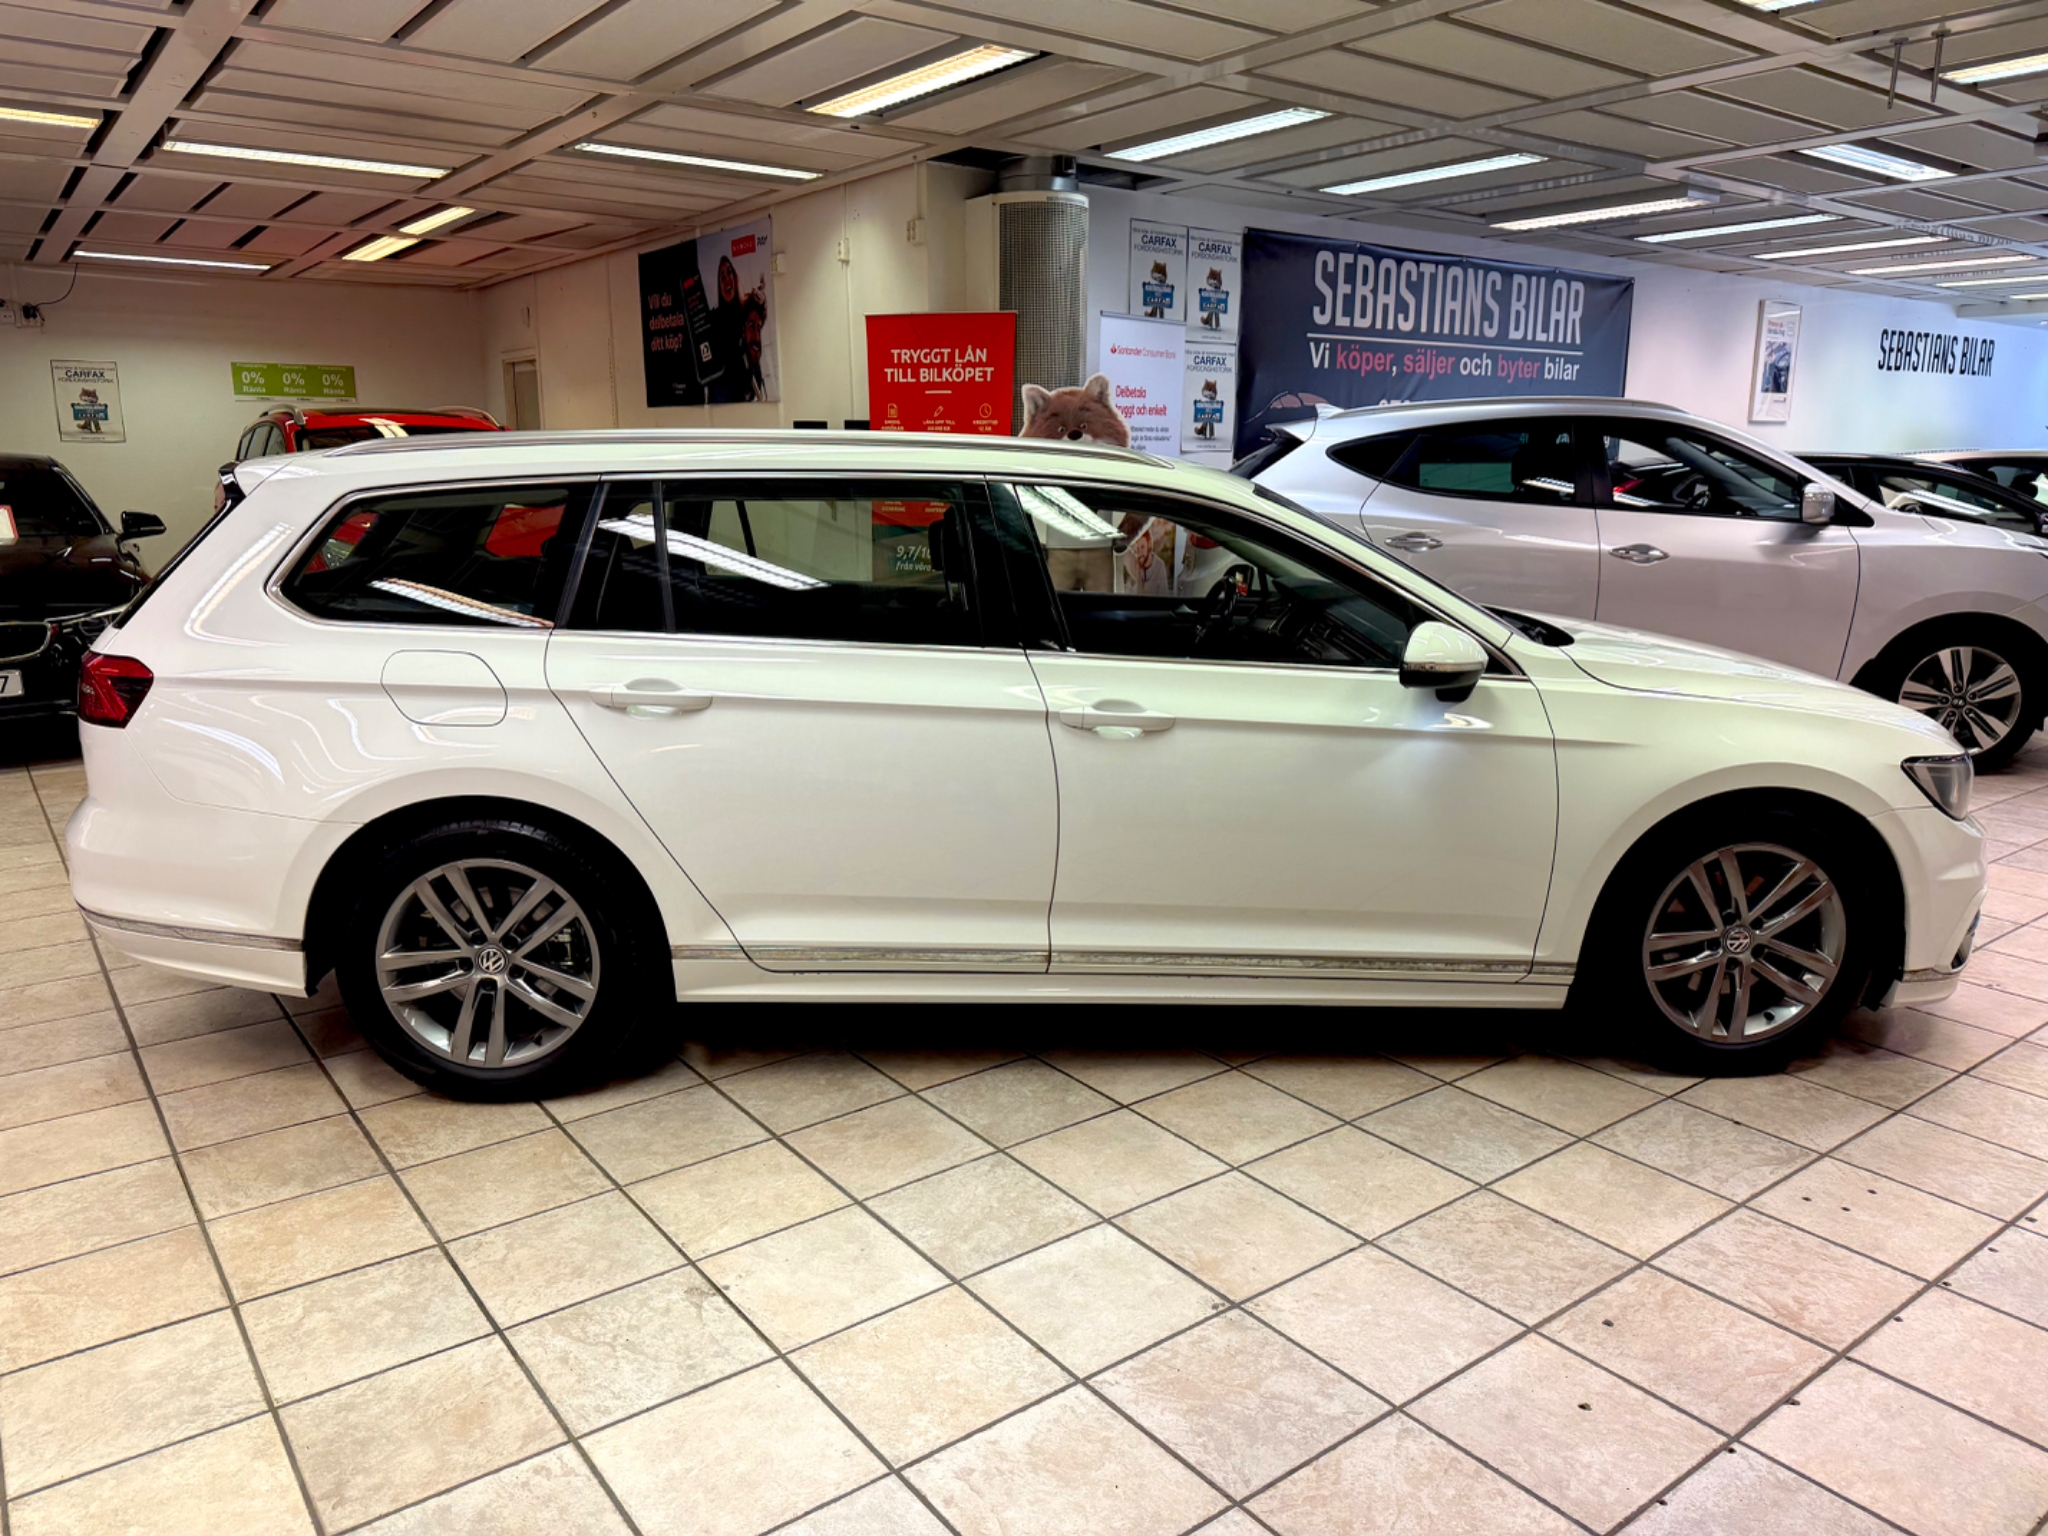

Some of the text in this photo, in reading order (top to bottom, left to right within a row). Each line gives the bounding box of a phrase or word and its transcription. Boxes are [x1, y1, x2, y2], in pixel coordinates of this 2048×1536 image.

[1140, 234, 1177, 249] CARFAX
[1198, 241, 1233, 256] CARFAX
[661, 291, 672, 308] du
[1312, 249, 1586, 345] SEBASTIANS BILAR
[890, 344, 988, 364] TRYGGT LÅN
[1193, 354, 1228, 367] CARFAX
[1877, 328, 1996, 378] SEBASTIANS BILAR
[1309, 341, 1581, 384] Vi köper, säljer och byter bilar
[241, 370, 265, 385] 0%
[282, 372, 305, 386] 0%
[322, 373, 344, 387] 0%
[884, 363, 995, 383] TILL BILKÖPET
[243, 385, 266, 394] Ränta
[283, 386, 306, 395] Ränta
[323, 387, 345, 396] Ränta
[1115, 384, 1147, 399] Delbetala
[1136, 403, 1147, 416] och
[1148, 403, 1167, 417] enkelt
